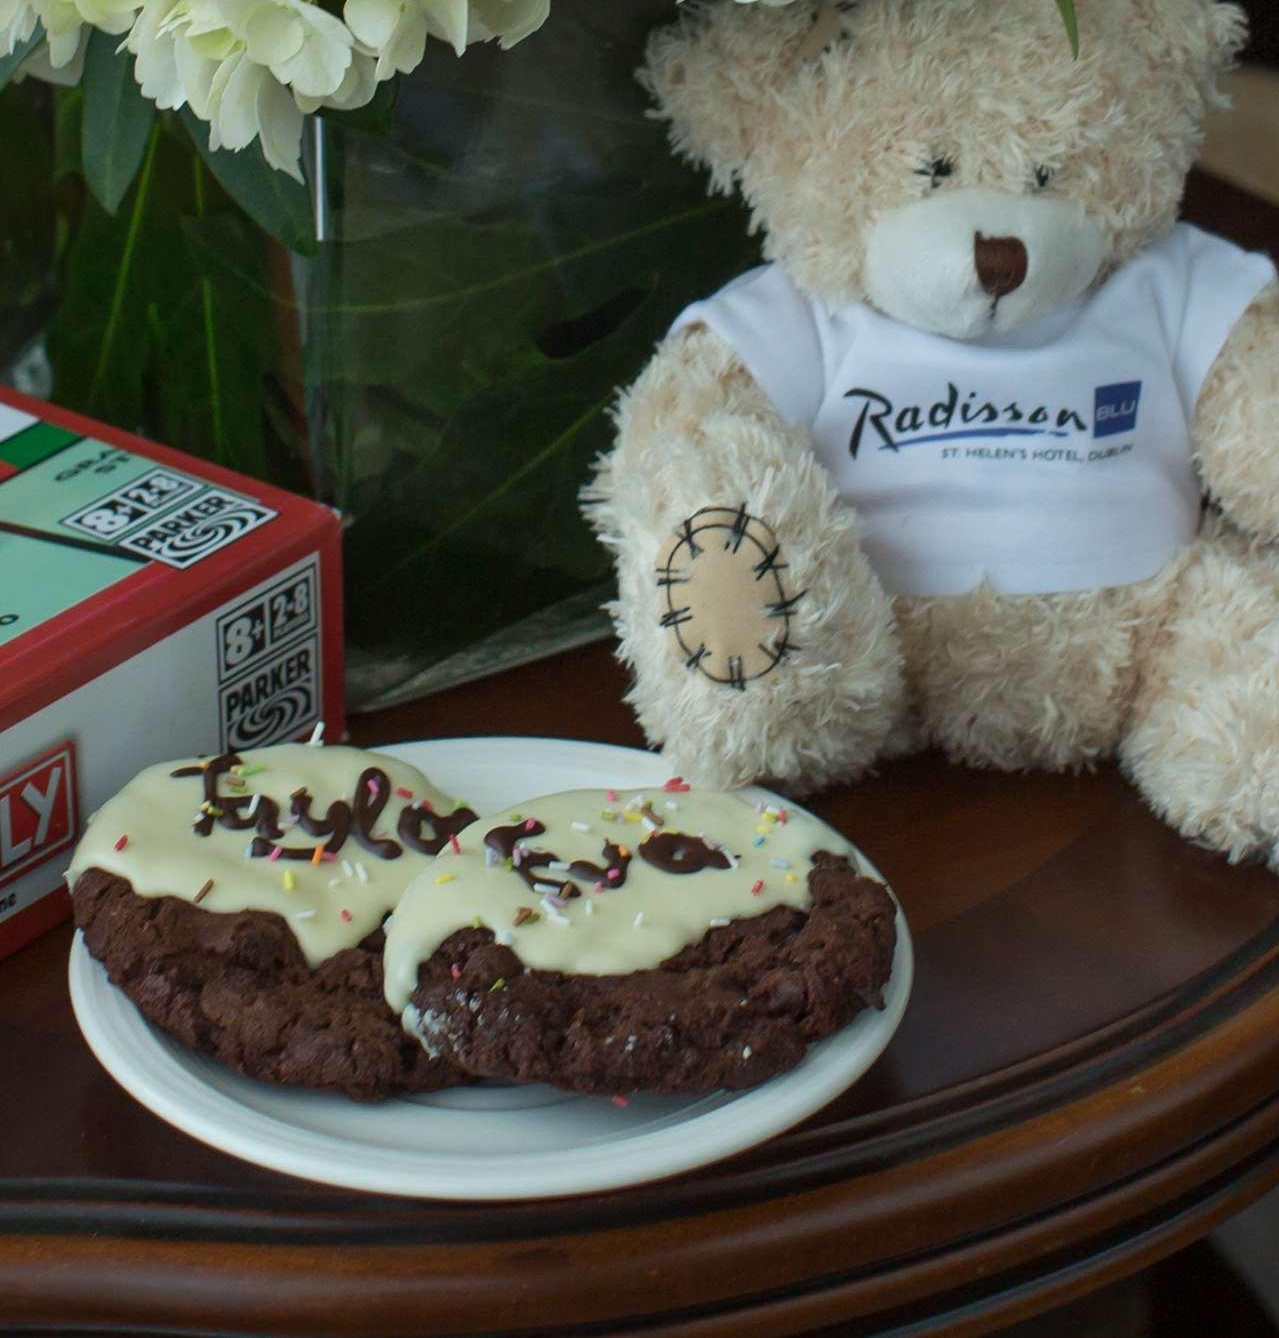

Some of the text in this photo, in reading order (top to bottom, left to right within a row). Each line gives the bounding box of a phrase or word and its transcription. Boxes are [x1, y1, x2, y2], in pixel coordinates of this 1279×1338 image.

[843, 381, 1137, 461] Radisson BLU
[131, 494, 235, 552] PARKER
[225, 648, 311, 723] PARKER
